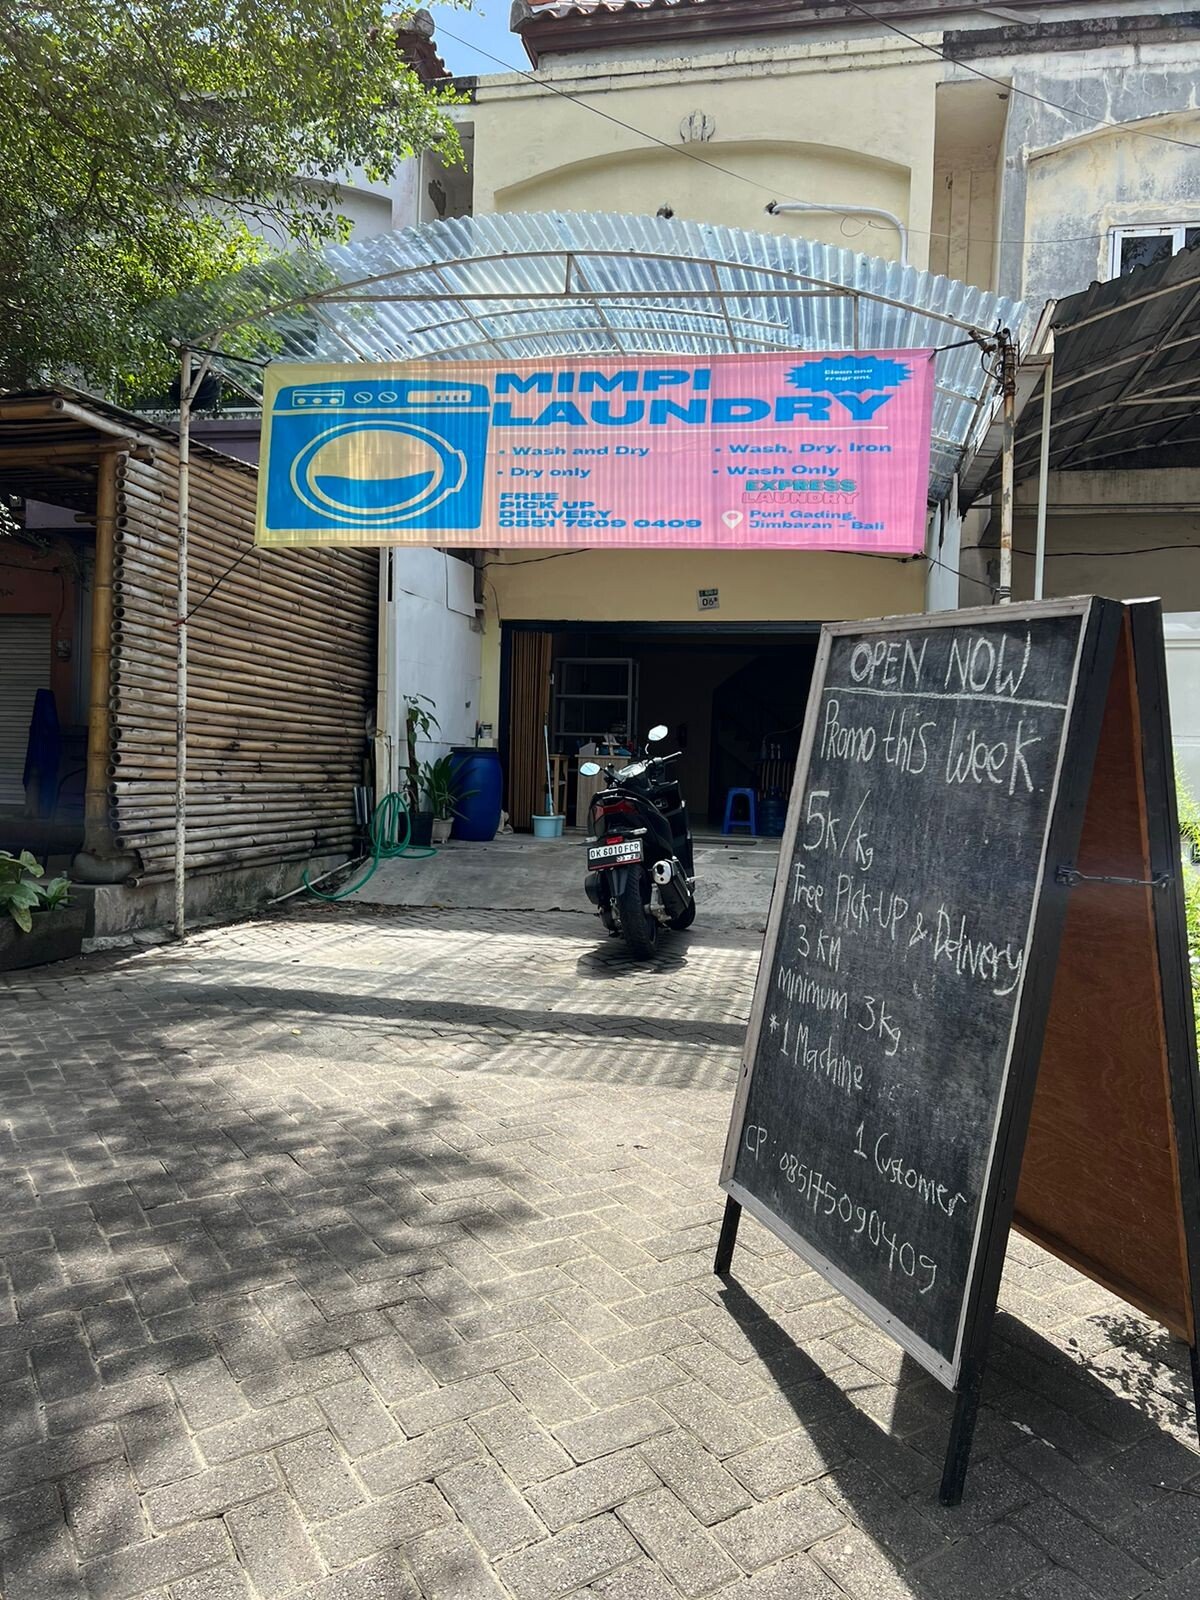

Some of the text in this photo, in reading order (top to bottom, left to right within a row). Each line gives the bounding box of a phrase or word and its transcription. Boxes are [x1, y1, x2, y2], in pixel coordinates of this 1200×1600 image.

[495, 369, 712, 394] MIMPI
[492, 394, 894, 427] LAUNDRY
[512, 446, 649, 456] Wash and Dry
[849, 443, 891, 453] Iron
[510, 467, 591, 478] Dry only
[727, 465, 839, 476] Wash Only
[745, 479, 857, 492] EXPRESS
[500, 492, 559, 500] FREE
[741, 492, 860, 504] LAUNDRY
[500, 501, 595, 509] PICK UP
[499, 510, 612, 519] DELIVERY
[749, 510, 785, 519] Puri
[498, 519, 702, 528] 0851 7509 0409
[749, 520, 832, 529] Jimbaran
[851, 521, 885, 530] Bali
[850, 631, 1031, 696] OPEN NOW
[590, 843, 639, 859] DK 6010 FCR
[793, 862, 824, 913] Free
[795, 1022, 863, 1096] Machine
